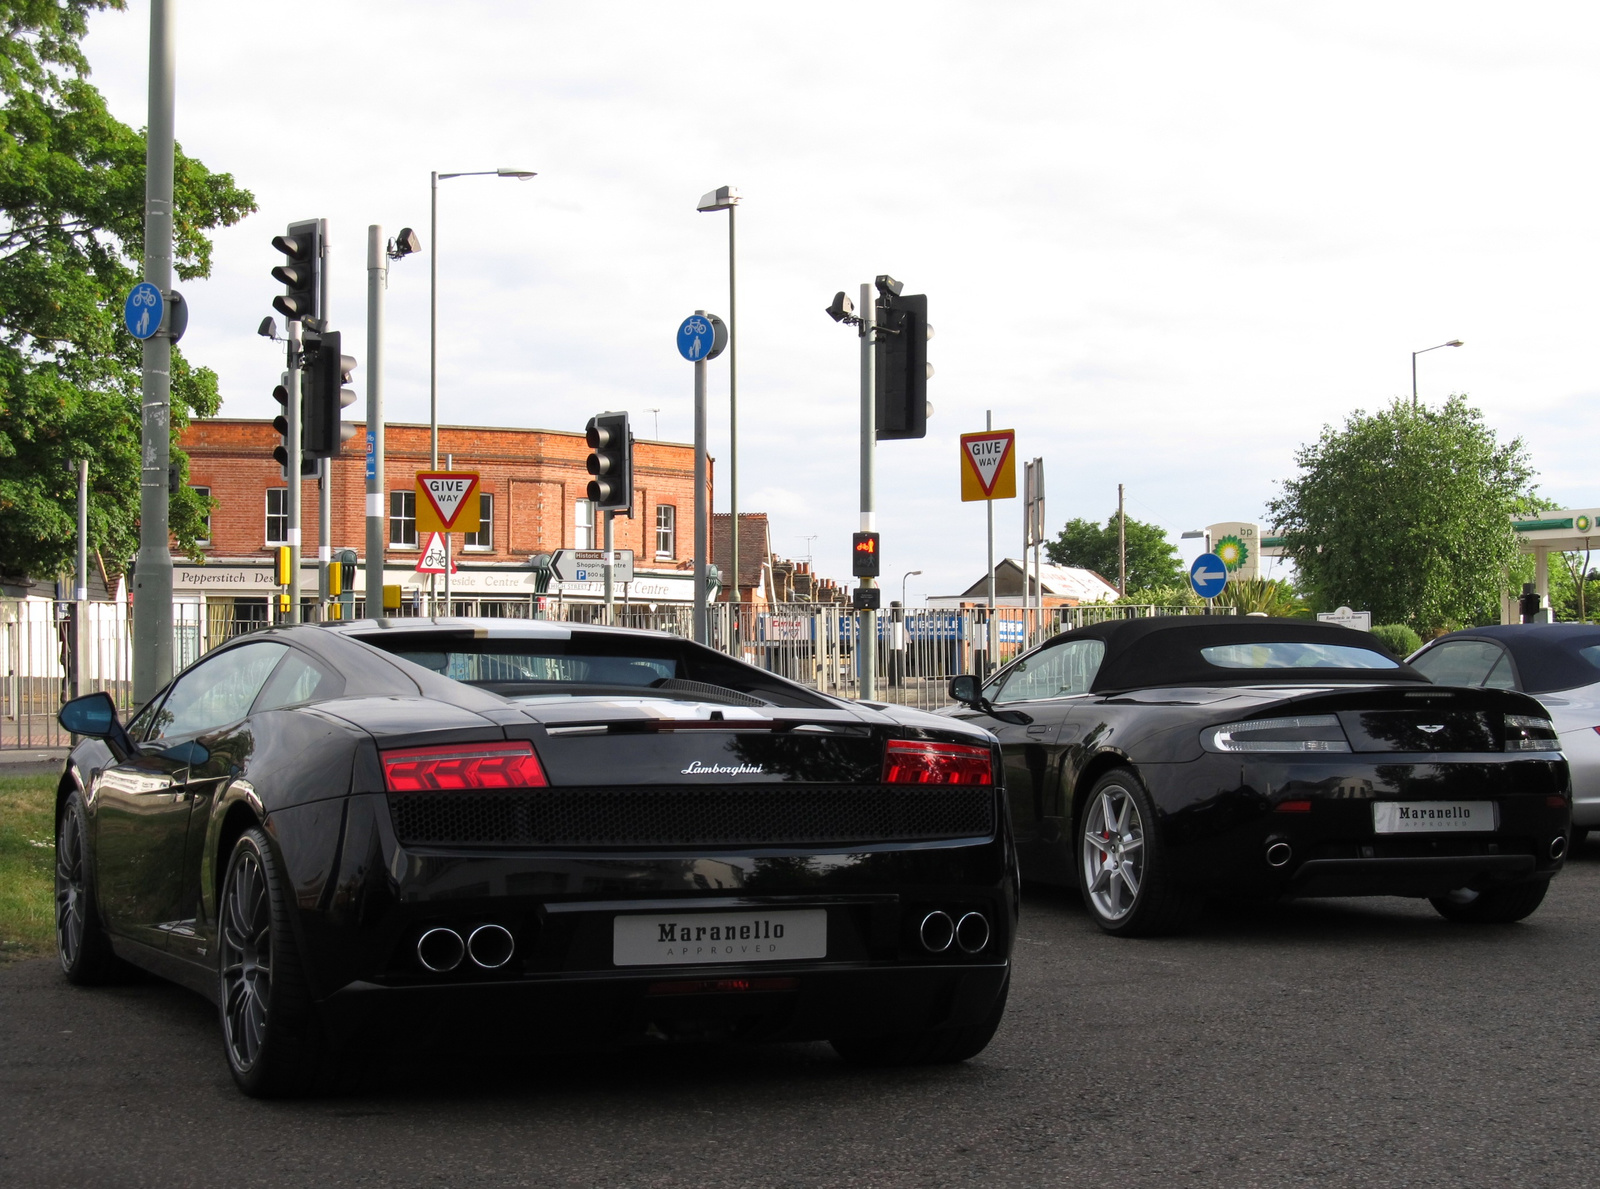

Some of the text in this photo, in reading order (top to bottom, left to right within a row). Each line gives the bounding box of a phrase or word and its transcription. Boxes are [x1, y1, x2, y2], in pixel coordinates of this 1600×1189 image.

[972, 441, 1001, 456] GIVE
[979, 457, 997, 467] WAY
[430, 480, 463, 492] GIVE
[437, 494, 459, 502] WAY
[1240, 527, 1253, 537] bp
[181, 572, 274, 584] Pepperstitch Des
[484, 574, 519, 587] Centre
[634, 581, 669, 595] Centre
[680, 760, 764, 777] Lamborghini
[1399, 806, 1471, 819] Maranello
[657, 920, 785, 943] Maranello
[667, 943, 777, 956] APPROVED
